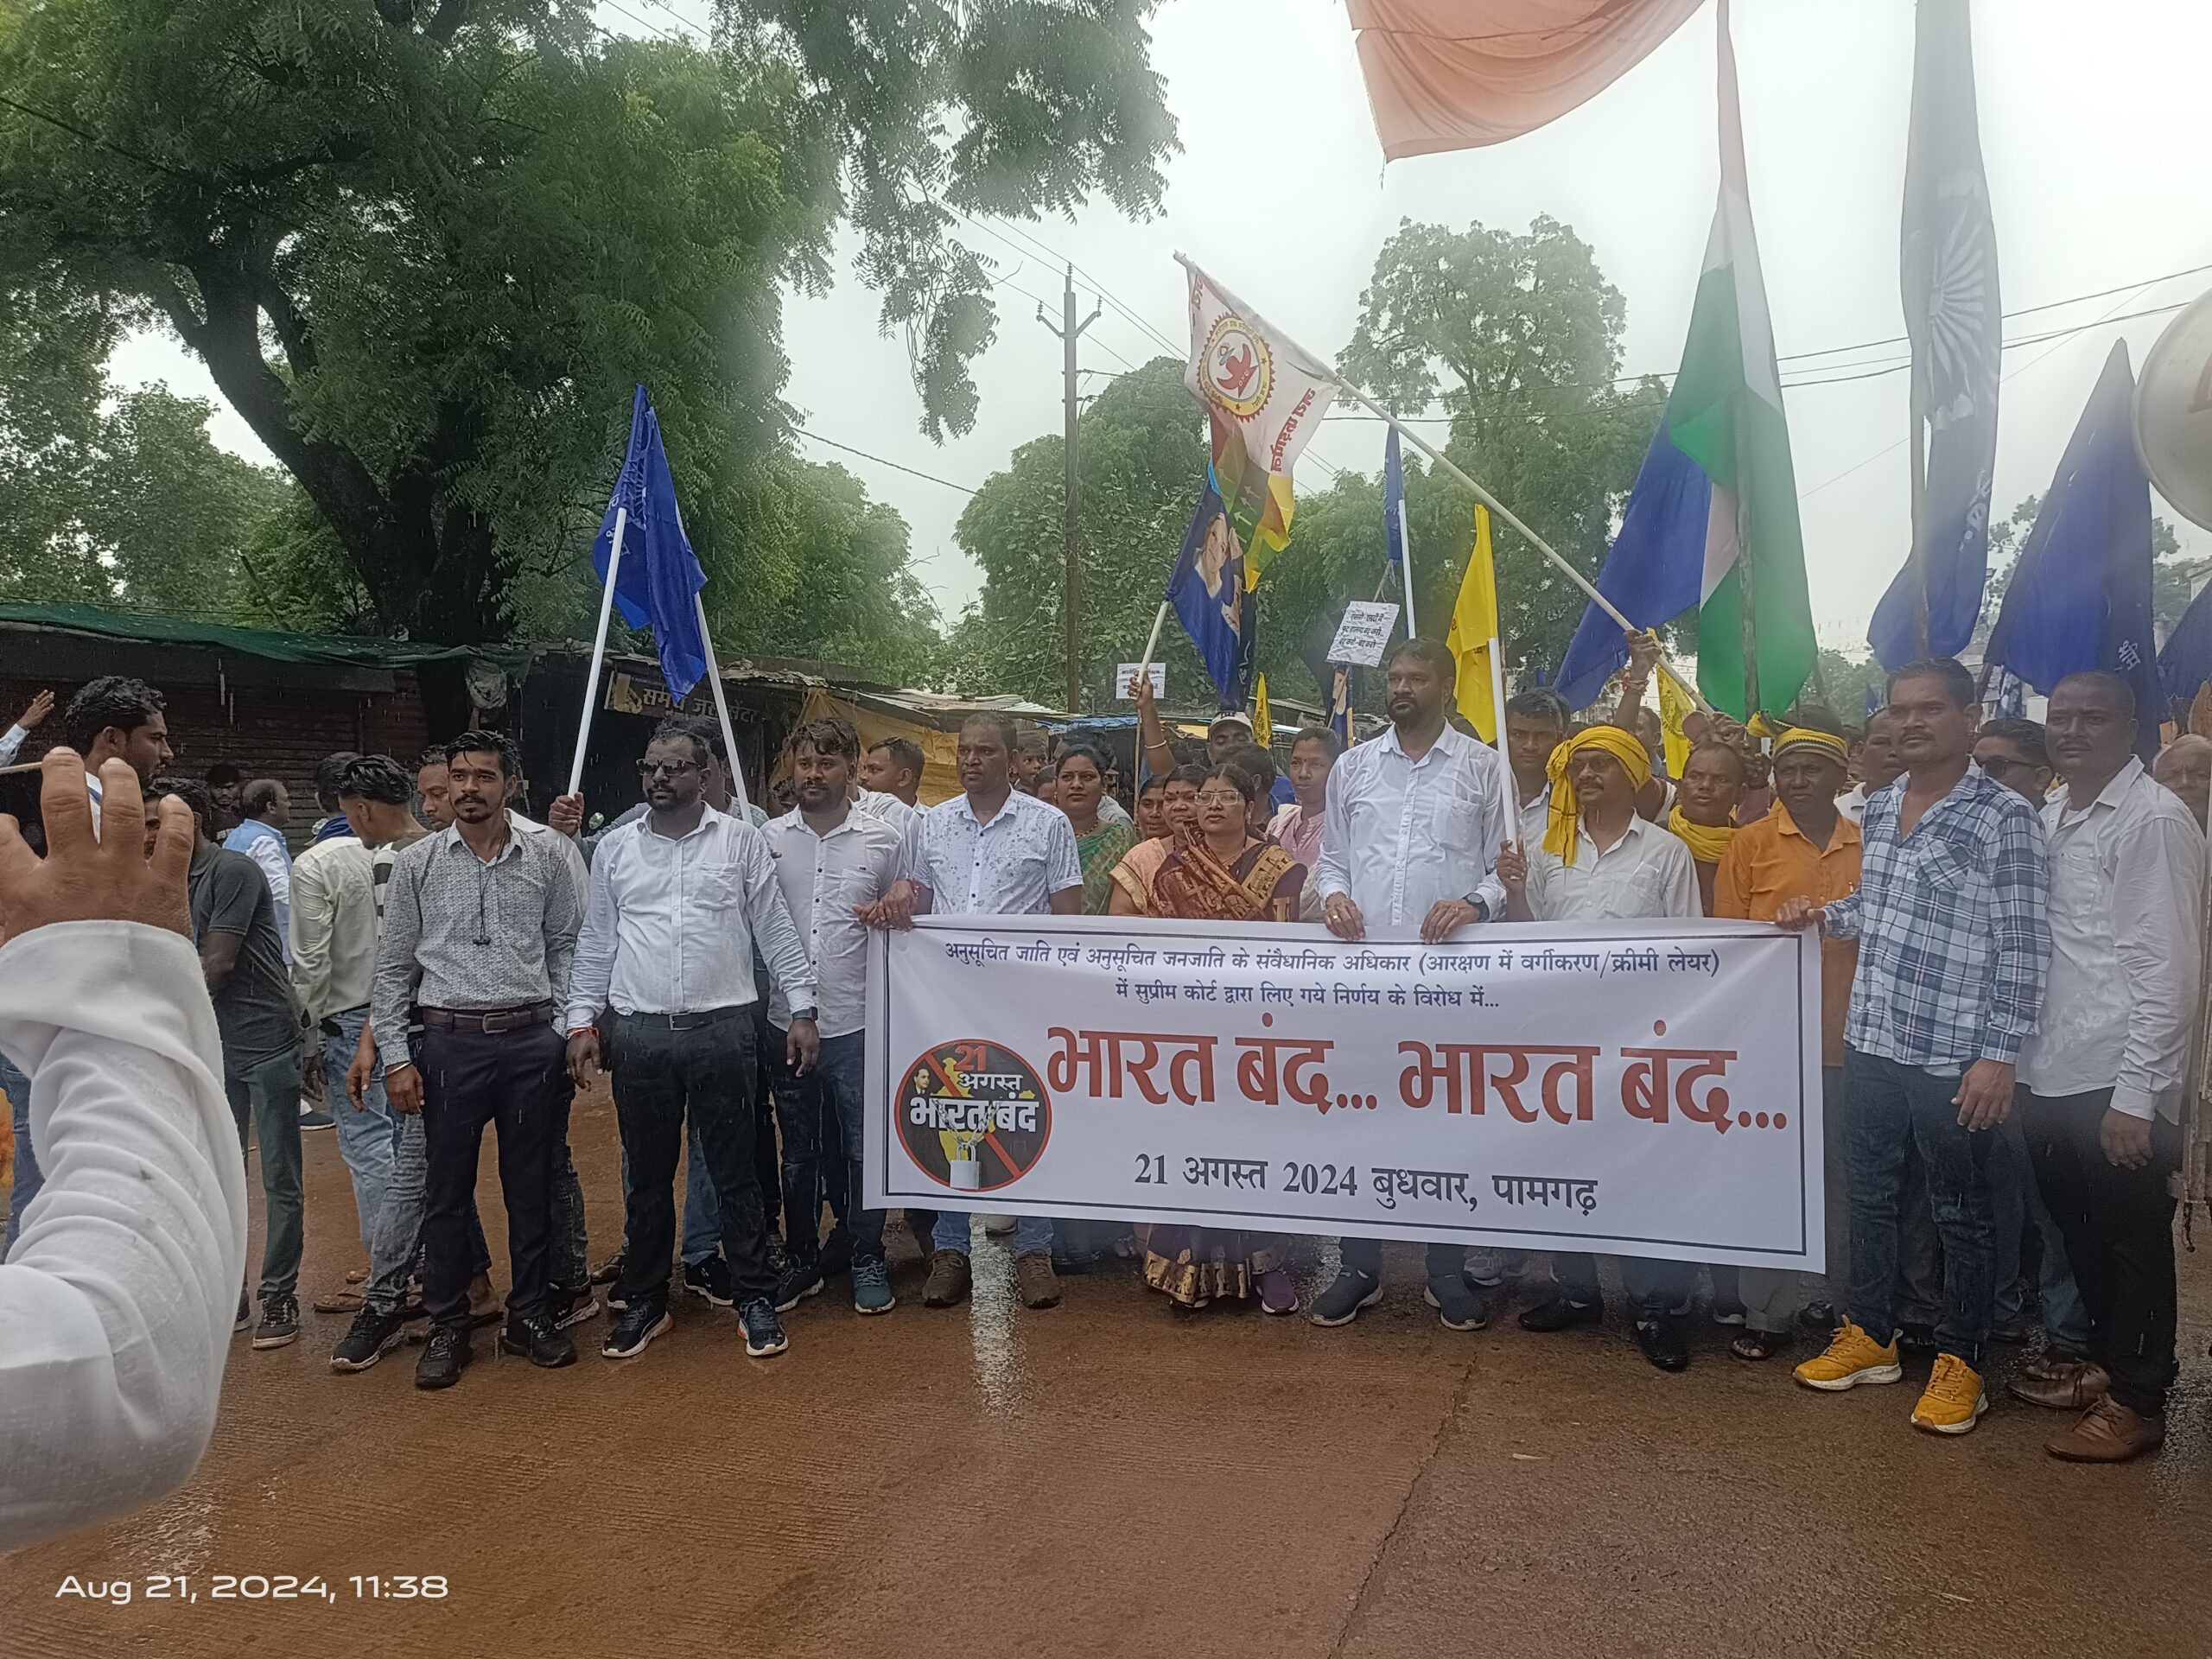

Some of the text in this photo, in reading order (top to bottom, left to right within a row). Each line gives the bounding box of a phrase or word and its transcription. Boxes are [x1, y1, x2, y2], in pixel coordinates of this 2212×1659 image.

[944, 937, 1010, 968] अनुसूचित
[1015, 938, 1052, 962] जाति
[1057, 941, 1081, 967] एवं
[1085, 942, 1157, 973] अनुसूचित
[1162, 944, 1226, 969] जनजाति
[1231, 946, 1251, 969] के
[1255, 945, 1335, 970] संवैधानिक
[1342, 949, 1411, 972] अधिकार
[1418, 950, 1491, 977] (आरक्षण
[1497, 949, 1514, 971] में
[1667, 946, 1720, 978] लेयर)
[1115, 977, 1129, 999] में
[1134, 978, 1178, 1005] सुप्रीम
[1183, 978, 1217, 1003] कोर्ट
[1223, 984, 1255, 1007] द्वारा
[1260, 981, 1294, 1007] लिए
[1300, 983, 1326, 1005] गये
[1332, 982, 1382, 1007] निर्णय
[1387, 982, 1407, 1007] के
[1413, 983, 1463, 1007] विरोध
[954, 1045, 987, 1071] 21
[1046, 1027, 1218, 1107] भारत
[1397, 1040, 1601, 1125] भारत
[958, 1073, 1023, 1090] अगस्त
[910, 1092, 1039, 1132] भारत बंद
[1134, 1153, 1599, 1217] 21 अगस्त 2024 बुधवार, पामगढ़
